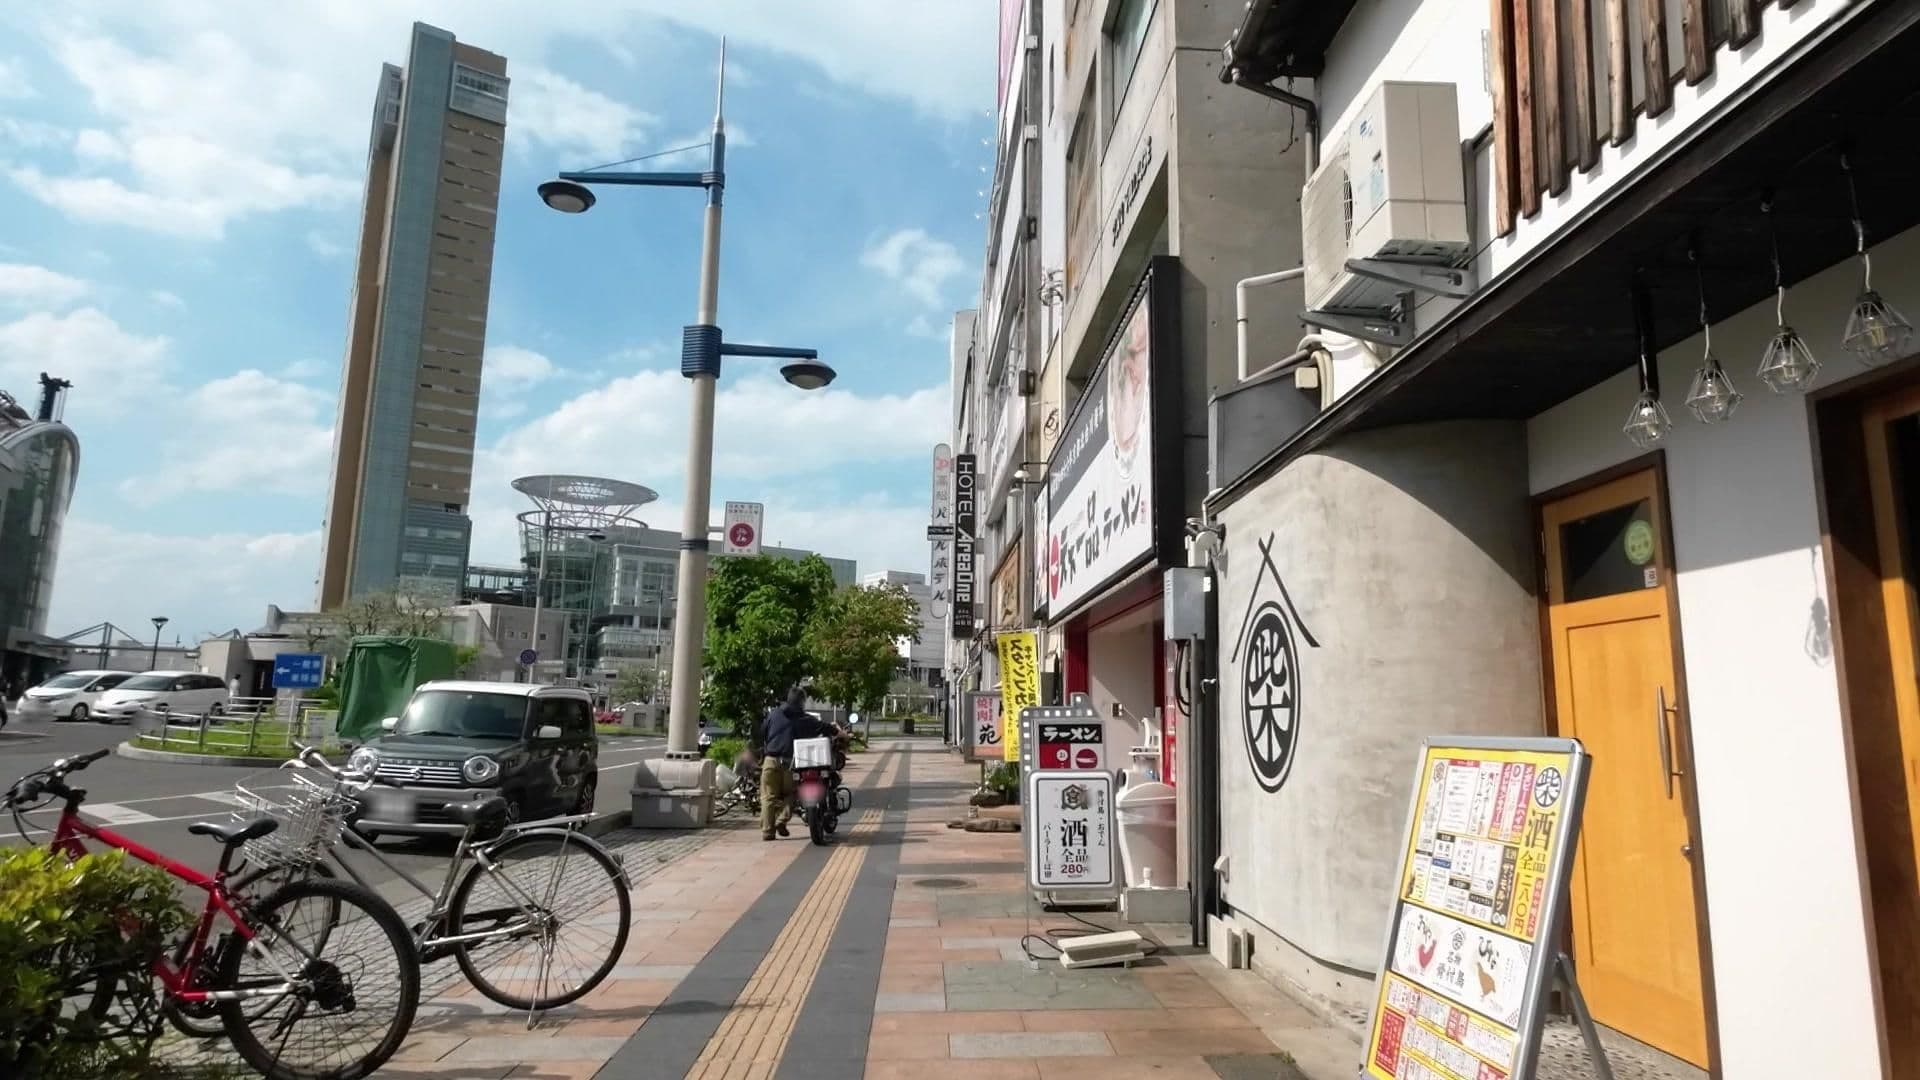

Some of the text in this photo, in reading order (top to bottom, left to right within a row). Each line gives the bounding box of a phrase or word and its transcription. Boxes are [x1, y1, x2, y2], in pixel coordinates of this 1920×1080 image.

[958, 461, 974, 524] HOTEL
[1043, 726, 1097, 742] ラーメン
[1061, 818, 1088, 847] 酒
[1525, 808, 1556, 850] 酒
[1062, 848, 1088, 863] 全品
[1520, 850, 1546, 874] 全品
[1514, 874, 1532, 935] 二八〇円
